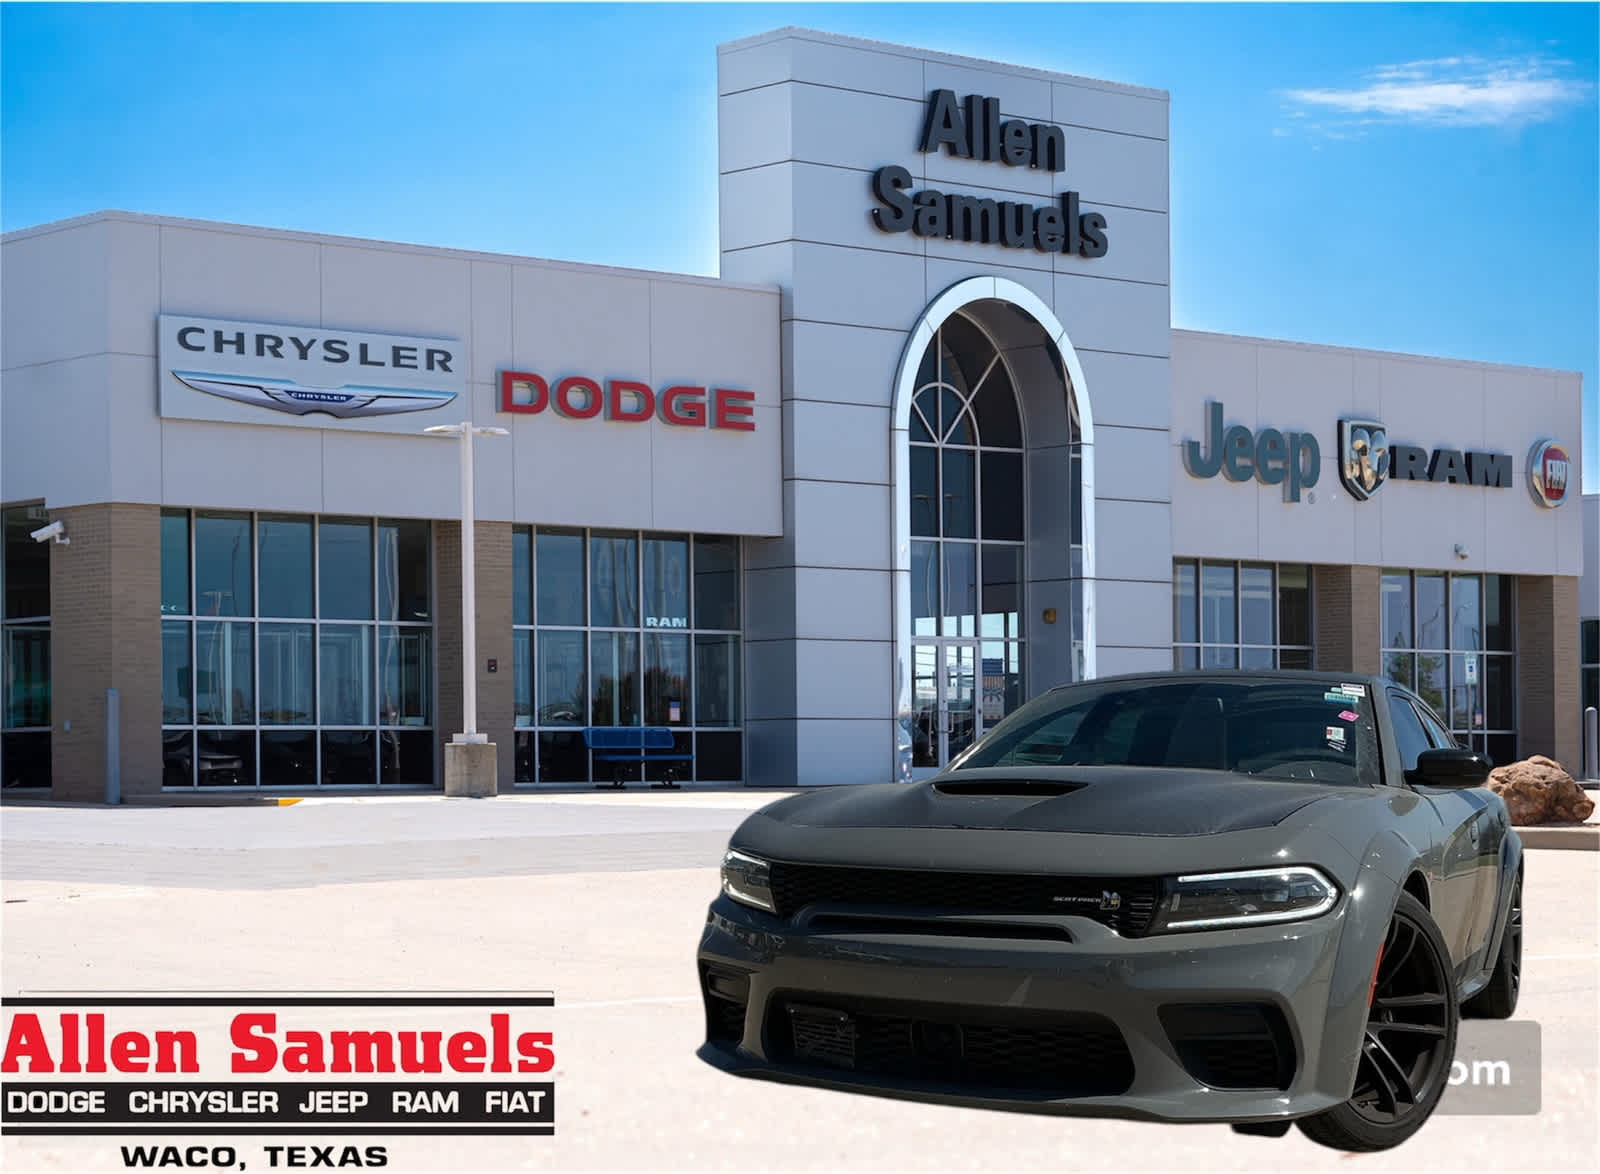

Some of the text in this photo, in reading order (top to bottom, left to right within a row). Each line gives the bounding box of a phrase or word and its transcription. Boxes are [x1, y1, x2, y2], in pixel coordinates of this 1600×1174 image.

[920, 89, 1066, 172] Allen
[871, 166, 1109, 258] Samuels
[176, 326, 453, 373] CHRYSLER
[291, 391, 347, 402] CHRYSLER
[496, 370, 757, 432] DODGE
[1182, 401, 1321, 503] Jeep
[1389, 444, 1513, 488] RAM
[1545, 459, 1568, 489] FIAT
[645, 616, 688, 628] RAM
